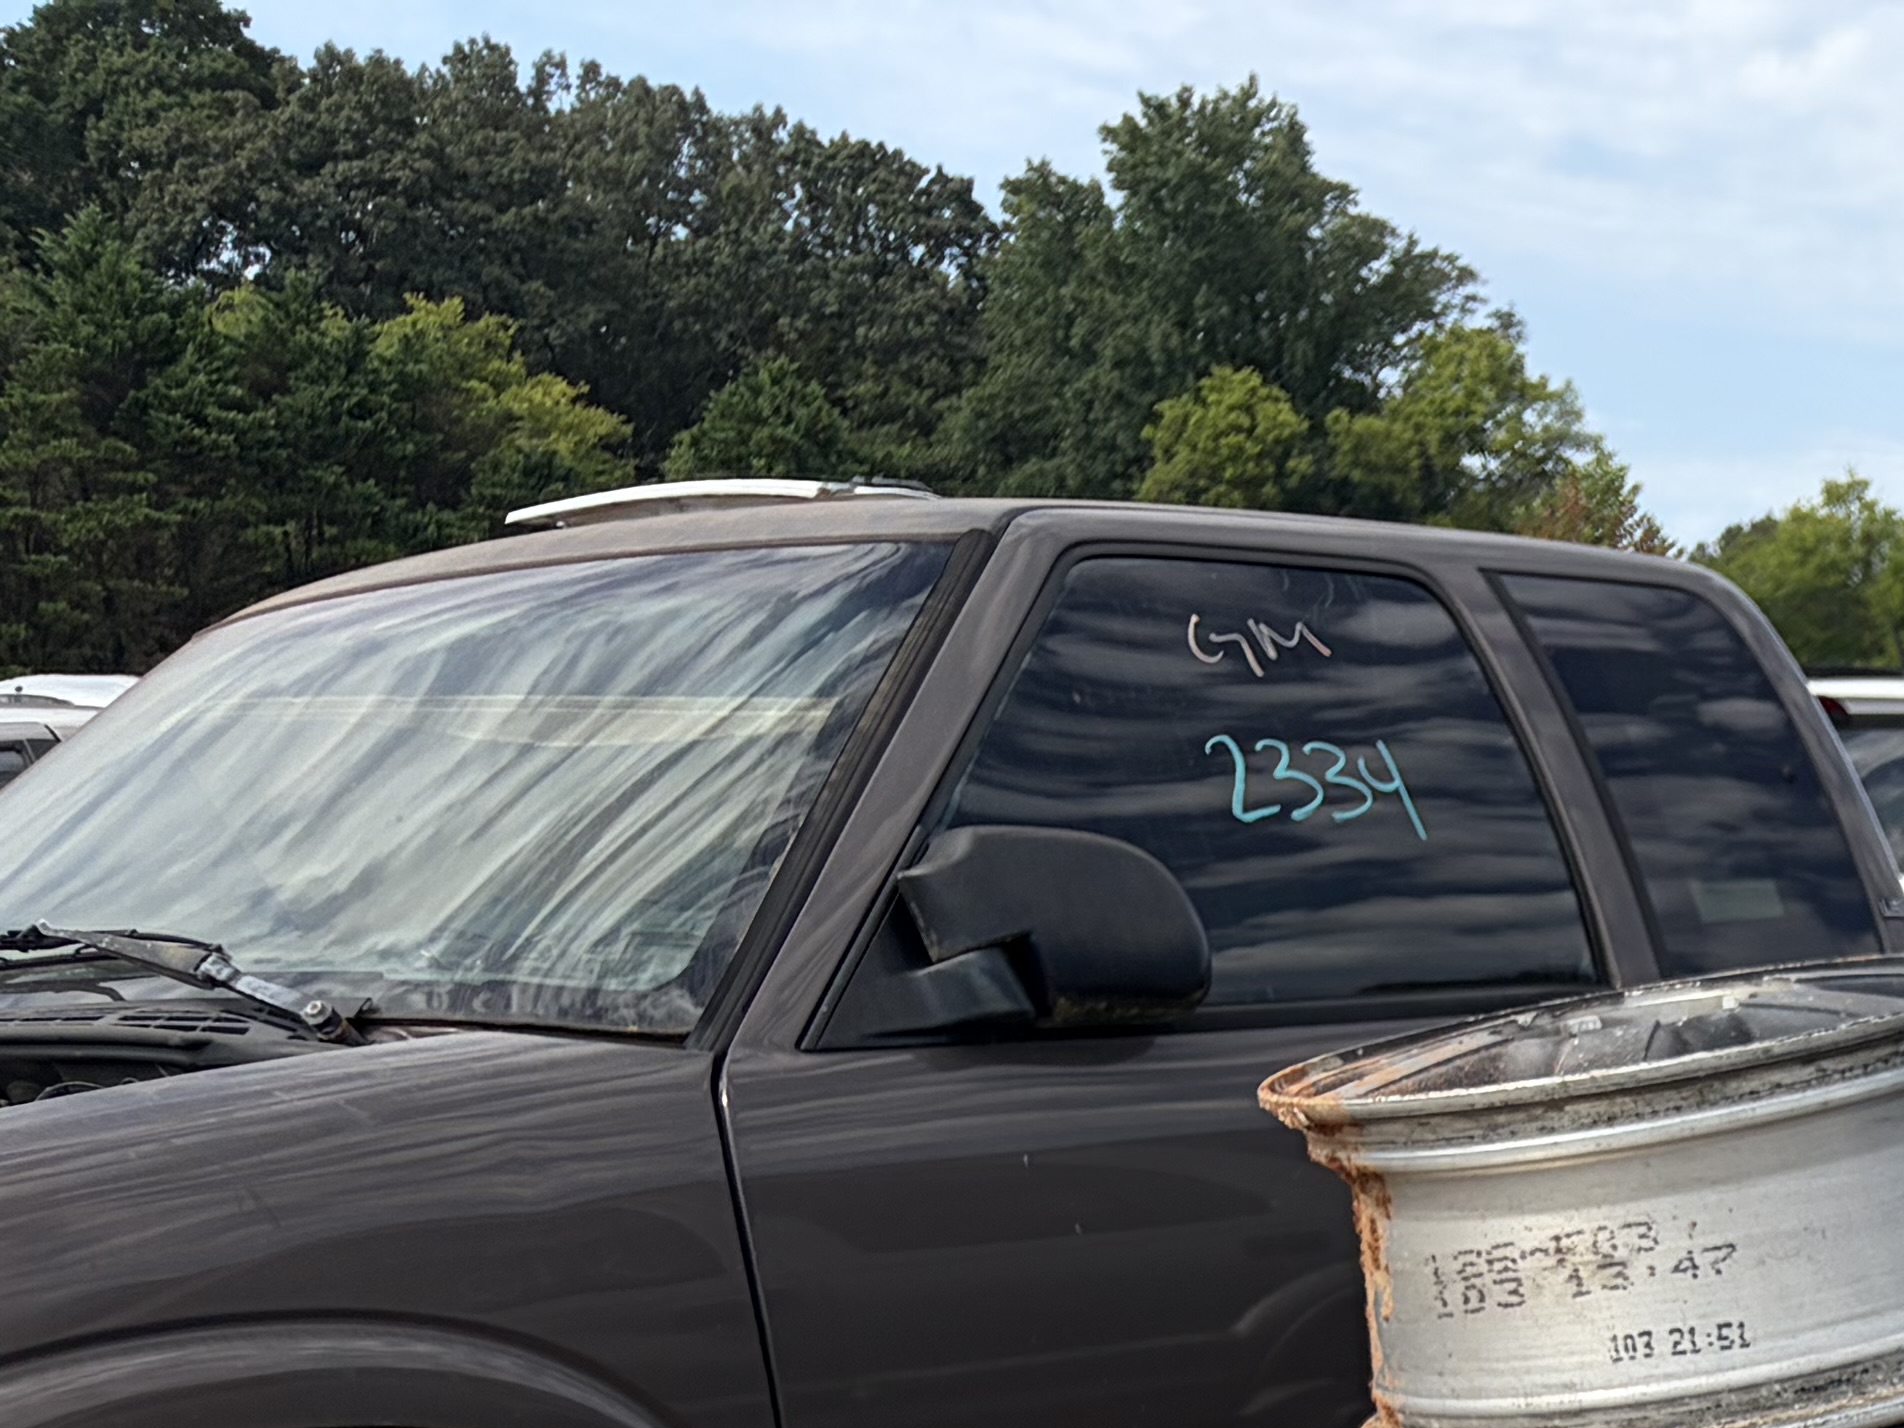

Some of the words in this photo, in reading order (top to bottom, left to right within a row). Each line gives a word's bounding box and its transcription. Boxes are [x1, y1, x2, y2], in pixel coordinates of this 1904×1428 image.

[1187, 613, 1332, 677] GM
[1204, 734, 1428, 841] 2334
[1608, 1329, 1655, 1364] 103
[1667, 1321, 1752, 1358] 21:51
